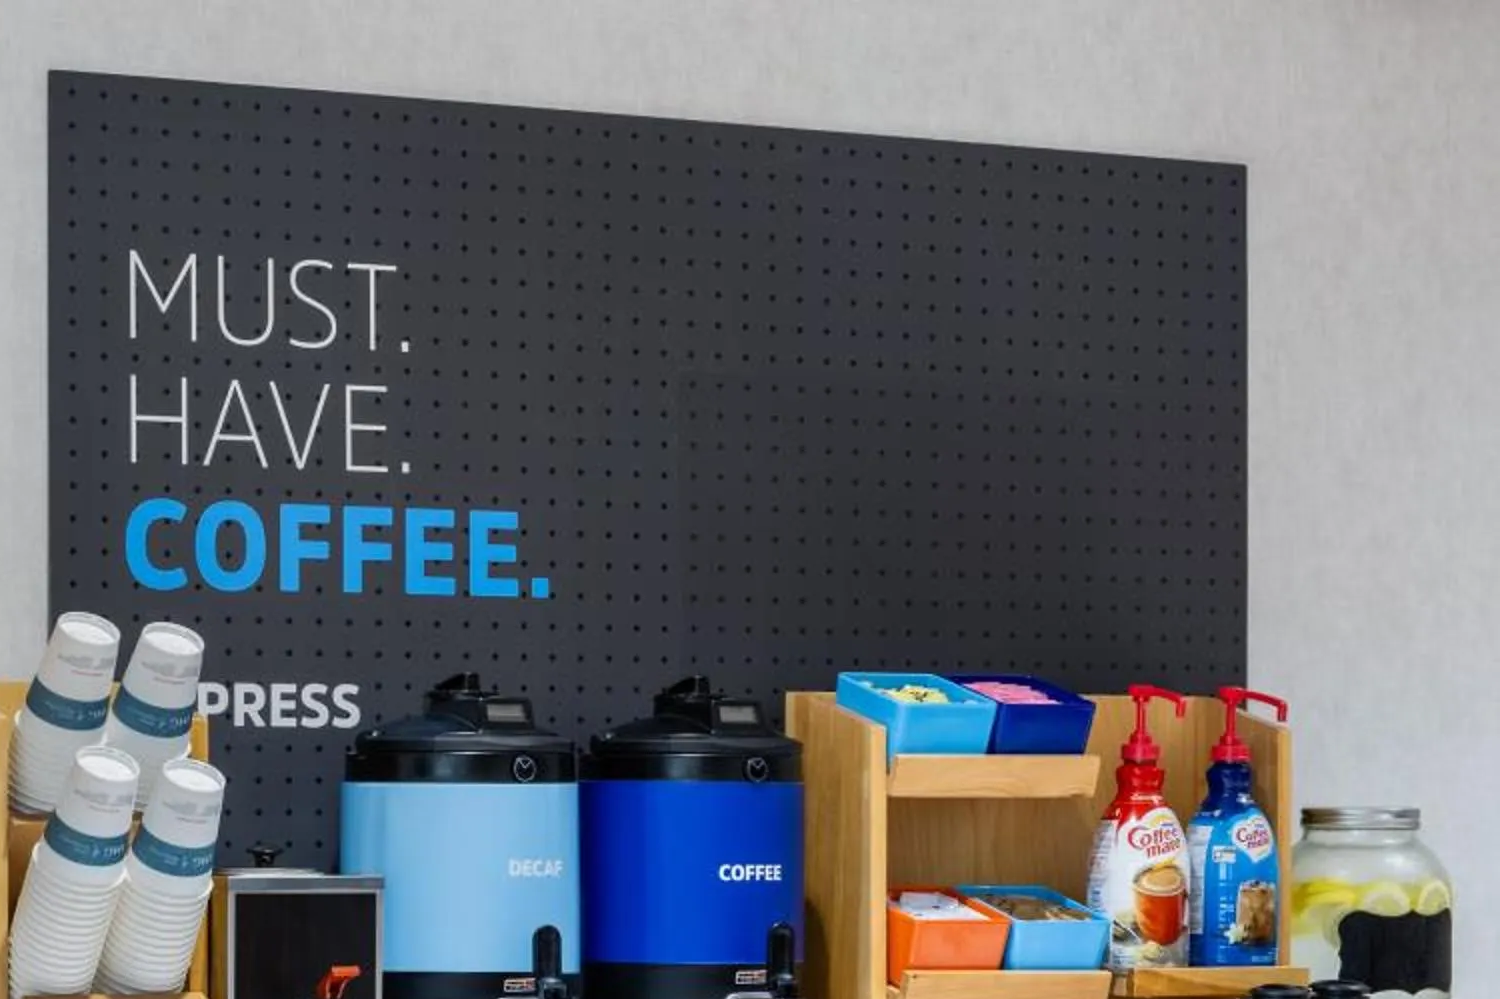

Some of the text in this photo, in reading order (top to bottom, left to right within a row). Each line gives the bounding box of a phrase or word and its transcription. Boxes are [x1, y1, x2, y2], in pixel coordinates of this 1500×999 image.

[128, 249, 411, 353] MUST.
[129, 373, 411, 474] HAVE.
[124, 497, 550, 599] COFFEE.
[508, 858, 564, 878] DECAF
[718, 863, 783, 882] COFFEE
